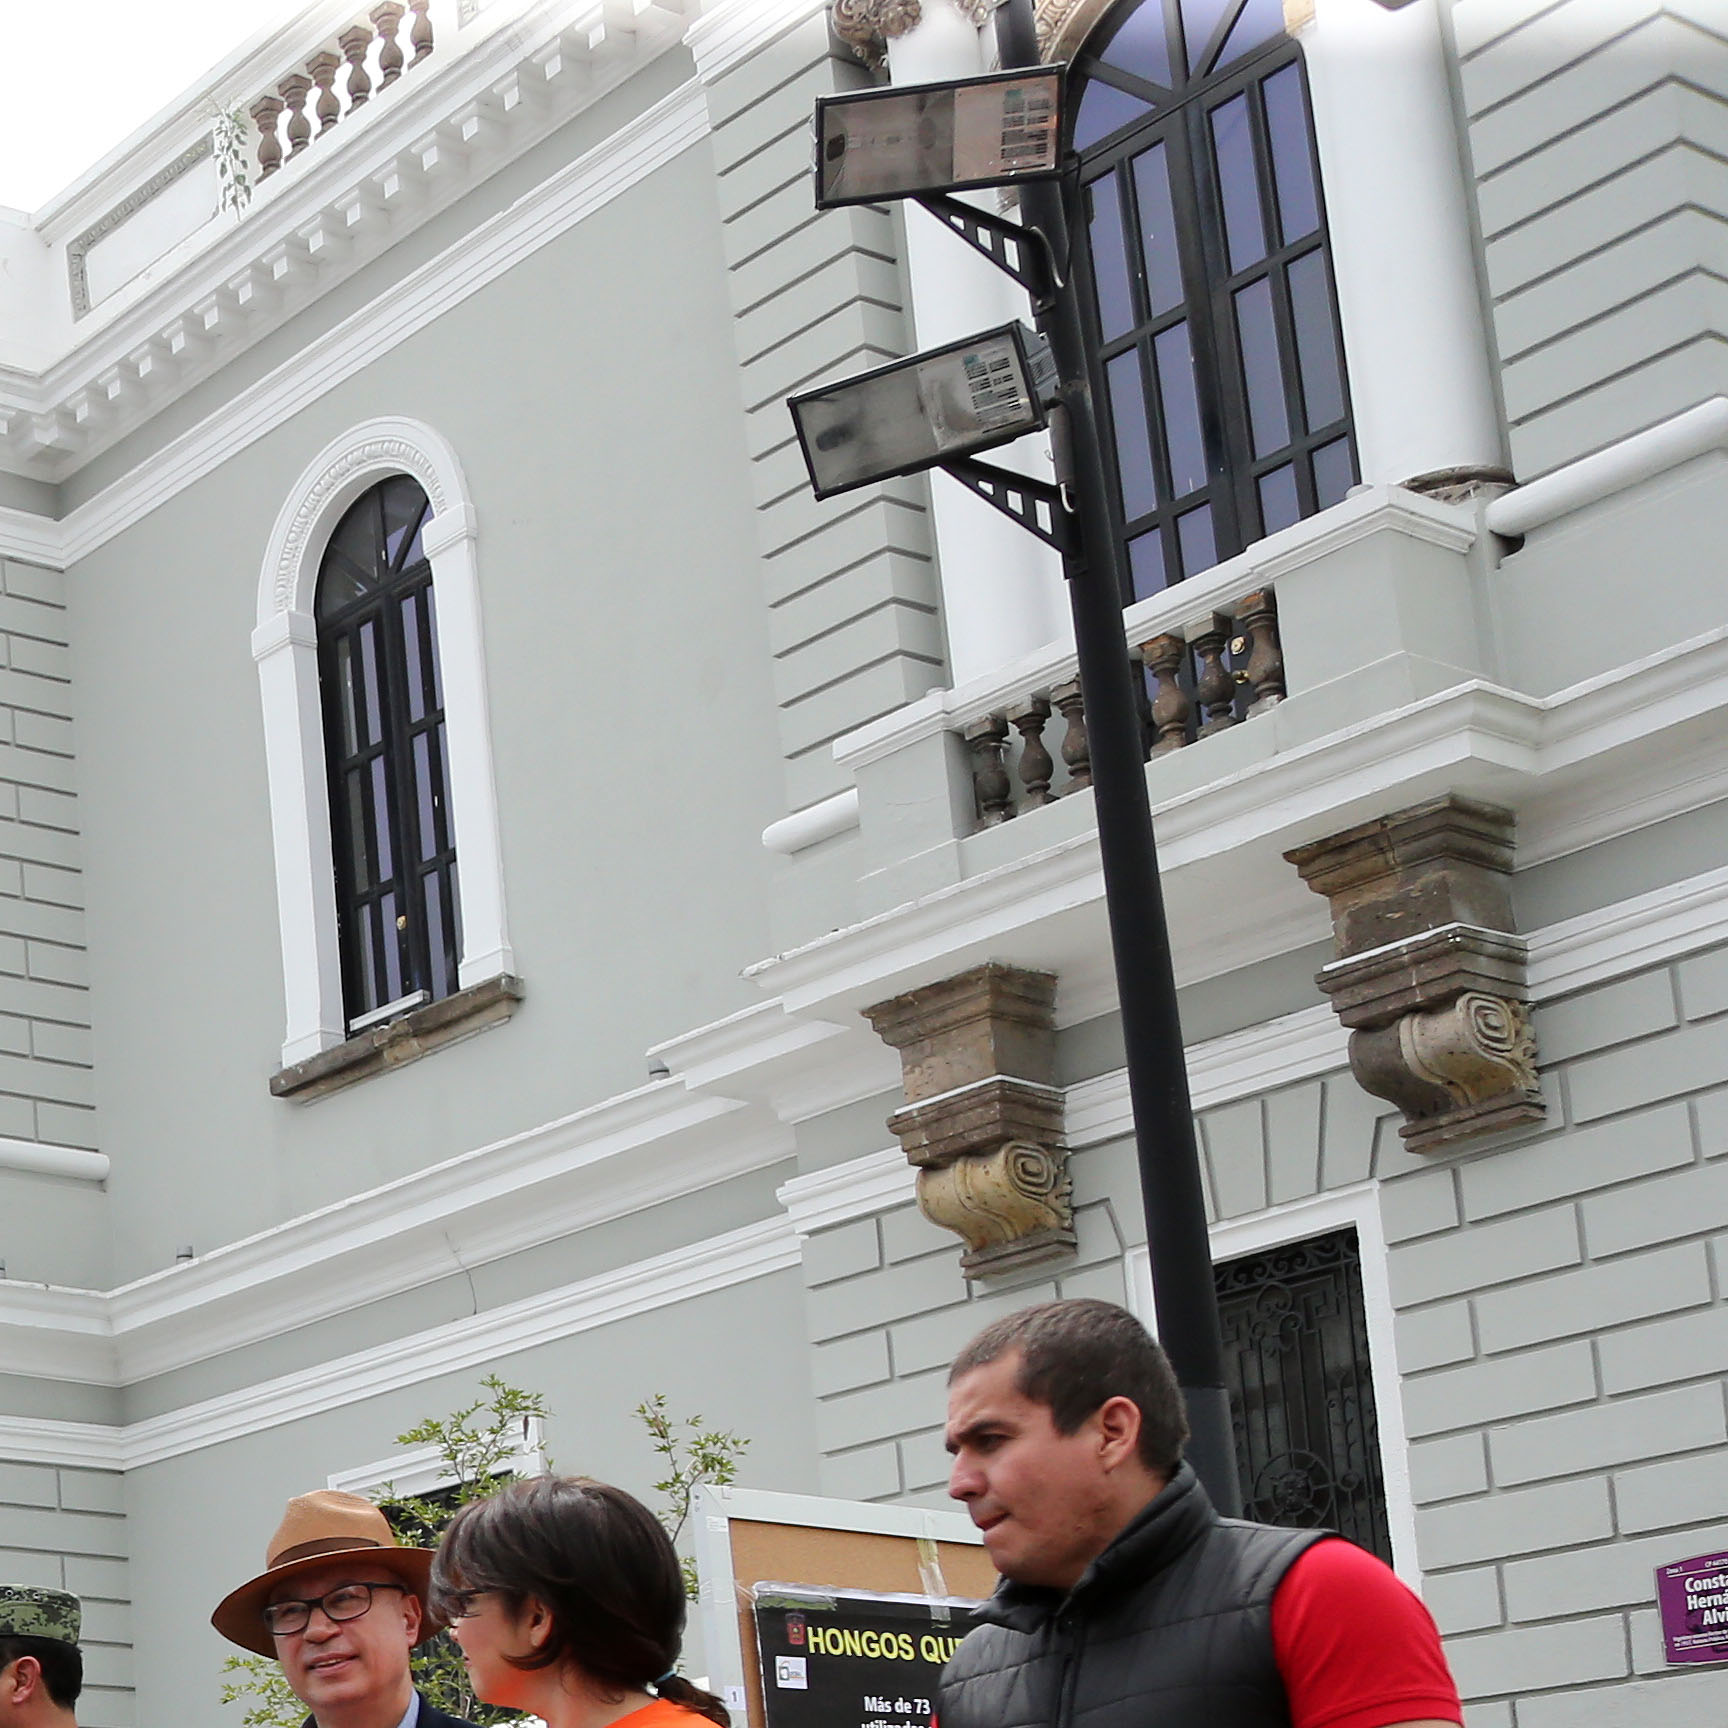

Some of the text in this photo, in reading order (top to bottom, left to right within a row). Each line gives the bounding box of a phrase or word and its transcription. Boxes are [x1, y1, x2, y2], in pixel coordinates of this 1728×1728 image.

[806, 1626, 915, 1662] HONGOS
[863, 1696, 931, 1715] Más de 73
